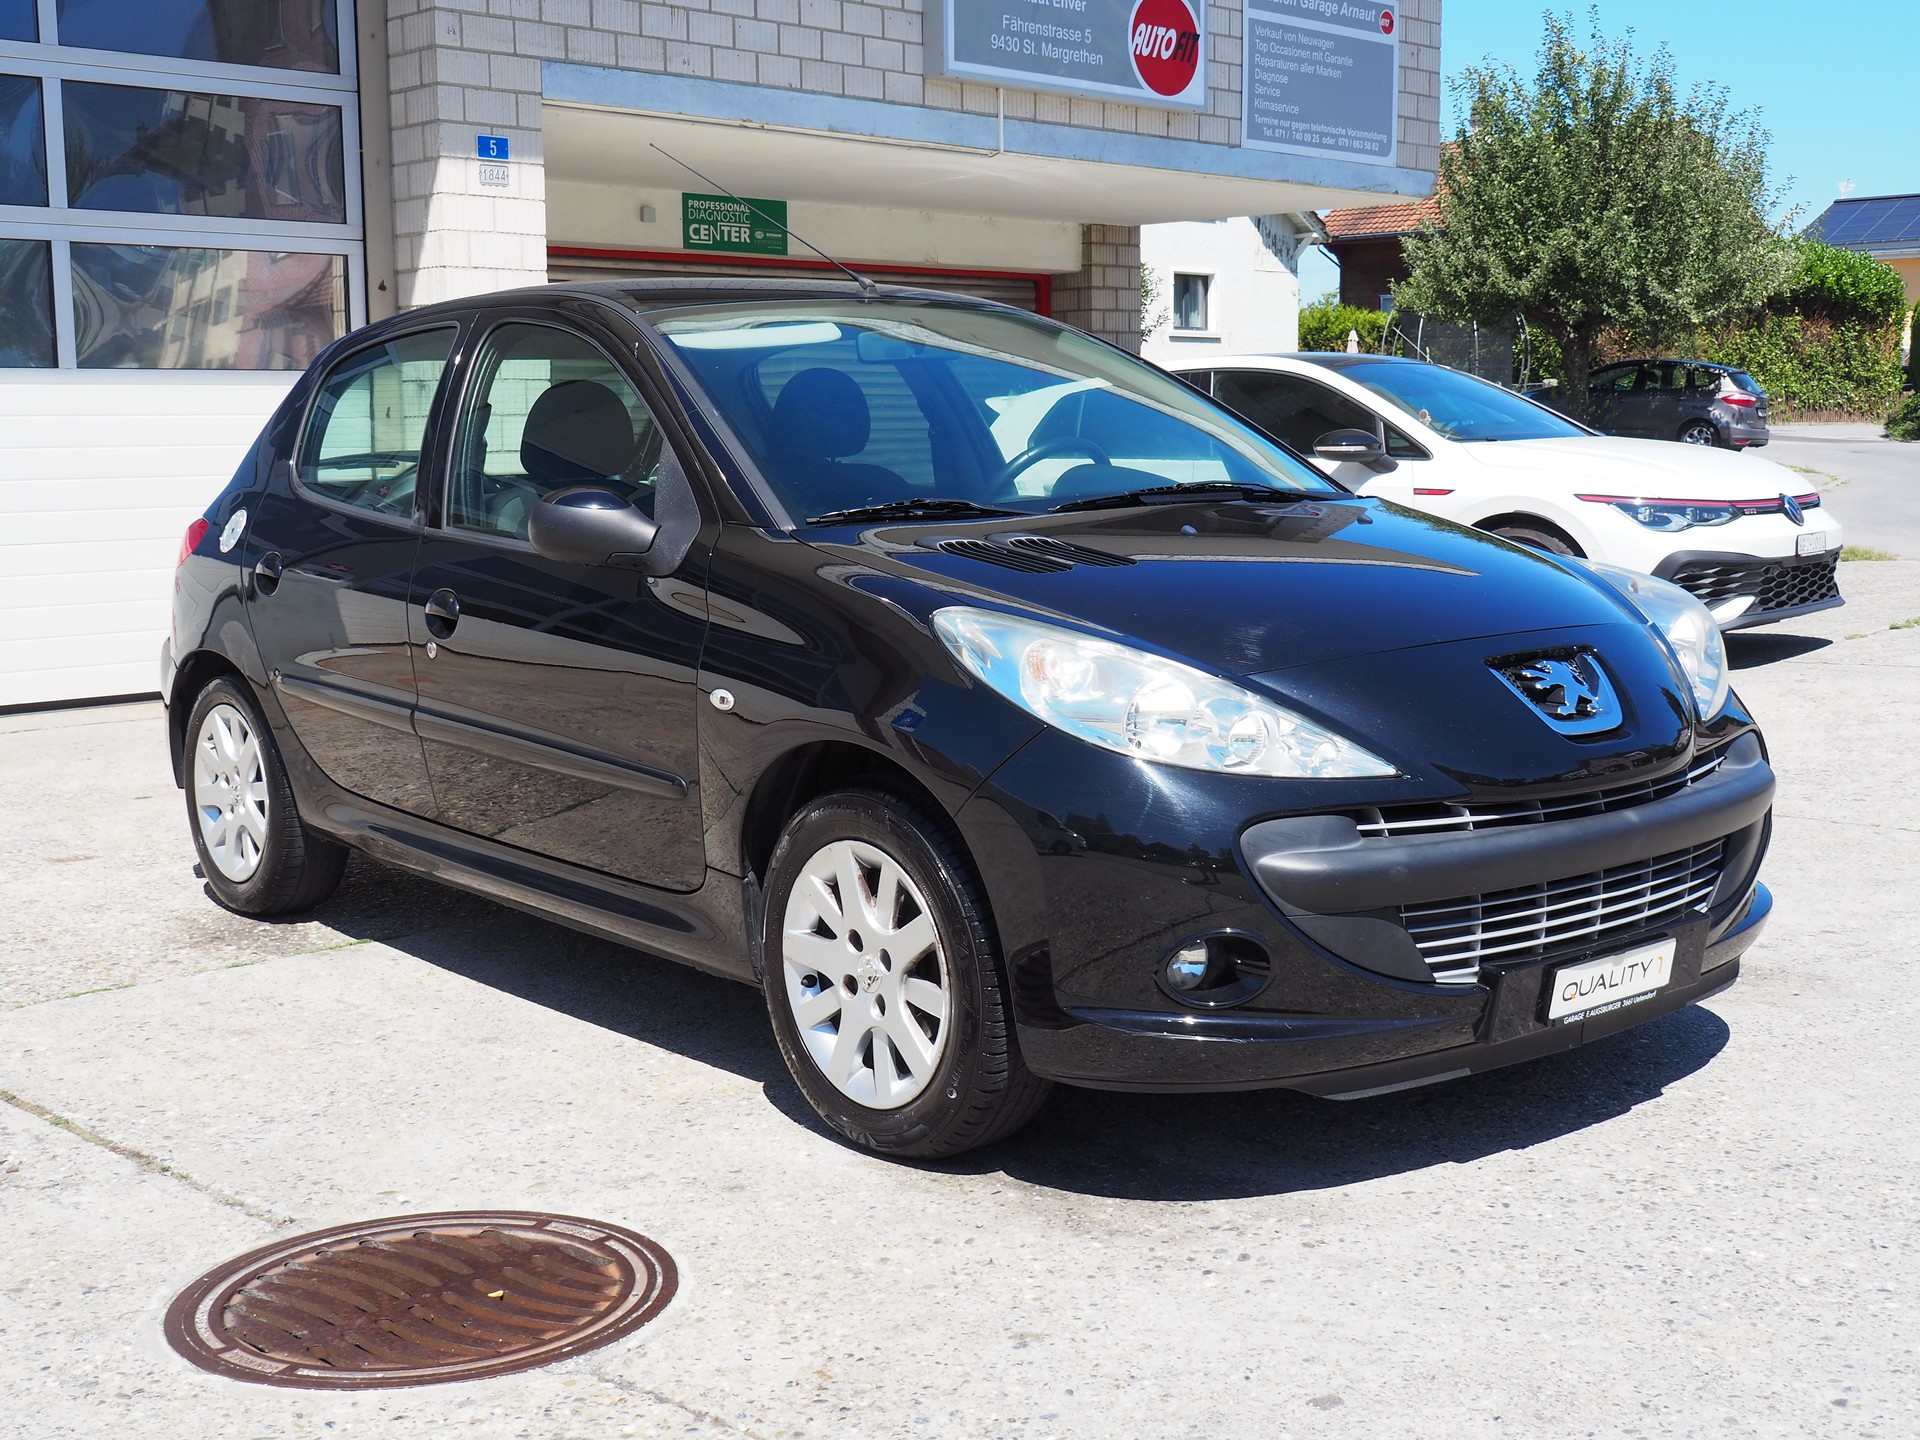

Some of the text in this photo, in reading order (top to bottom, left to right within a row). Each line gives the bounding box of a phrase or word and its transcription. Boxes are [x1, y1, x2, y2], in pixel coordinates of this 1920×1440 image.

[1300, 0, 1376, 22] Garage Arnaut
[1002, 14, 1092, 44] Fährenstrasse 5
[1255, 25, 1335, 50] Verkauf von Neuwagen
[990, 34, 1103, 67] 9430 St. Margrethen
[1132, 22, 1200, 63] AUTOFIT
[1255, 39, 1354, 67] Top Occasionen mit Garantie
[1254, 54, 1342, 79] Reparaturen aller Marken
[1254, 68, 1288, 84] Diagnose
[1254, 83, 1281, 97] Service
[1254, 98, 1299, 115] Klimaservice
[1254, 114, 1388, 144] Termine nur gegen telefonische Voranmeldung
[1263, 127, 1274, 137] Tel.
[1322, 135, 1336, 145] oder
[490, 139, 497, 156] 5
[483, 168, 506, 181] 1844
[688, 199, 750, 213] PROFESSIONAL
[688, 208, 750, 224] DIAGNOSTIC
[688, 222, 751, 244] CENTER
